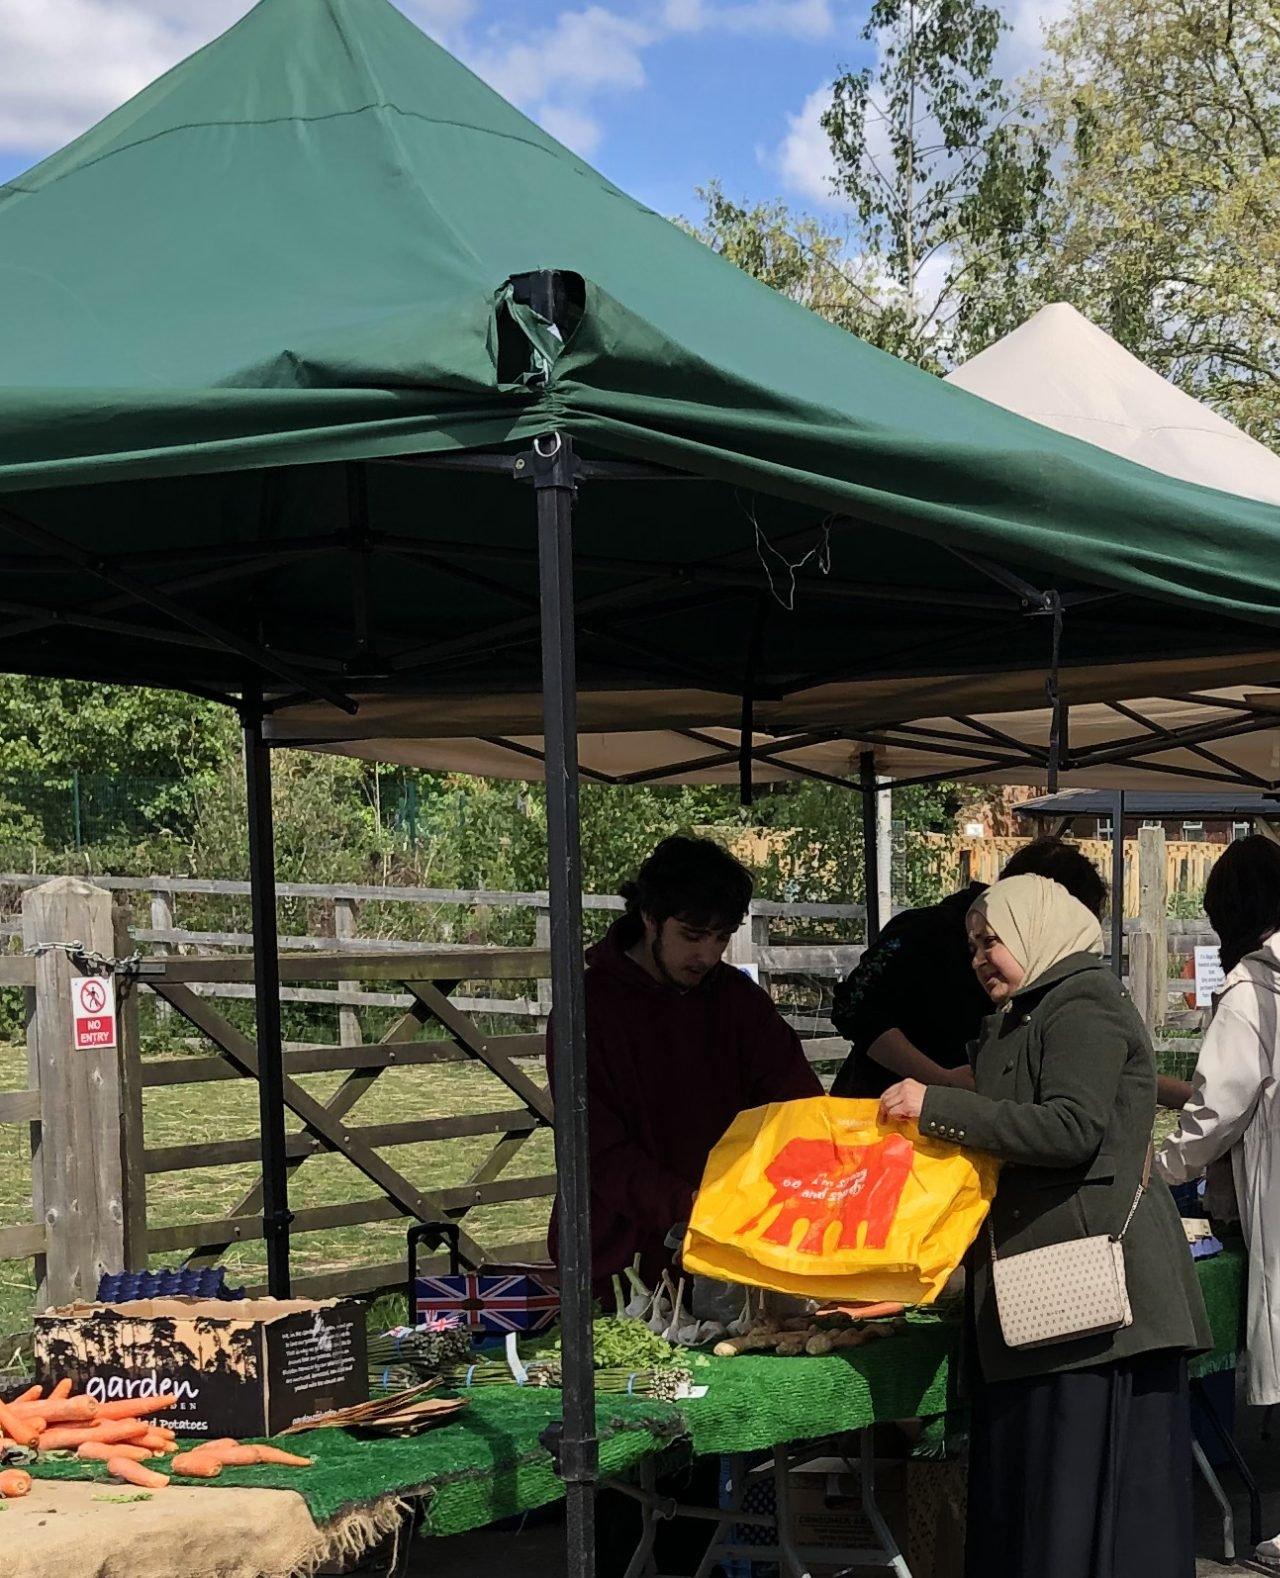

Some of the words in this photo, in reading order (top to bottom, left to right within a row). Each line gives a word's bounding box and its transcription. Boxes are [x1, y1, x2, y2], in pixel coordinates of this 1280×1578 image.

[87, 1020, 101, 1031] NO
[80, 1031, 109, 1044] ENTRY
[86, 1369, 199, 1404] garden
[160, 1418, 208, 1431] Potatoes
